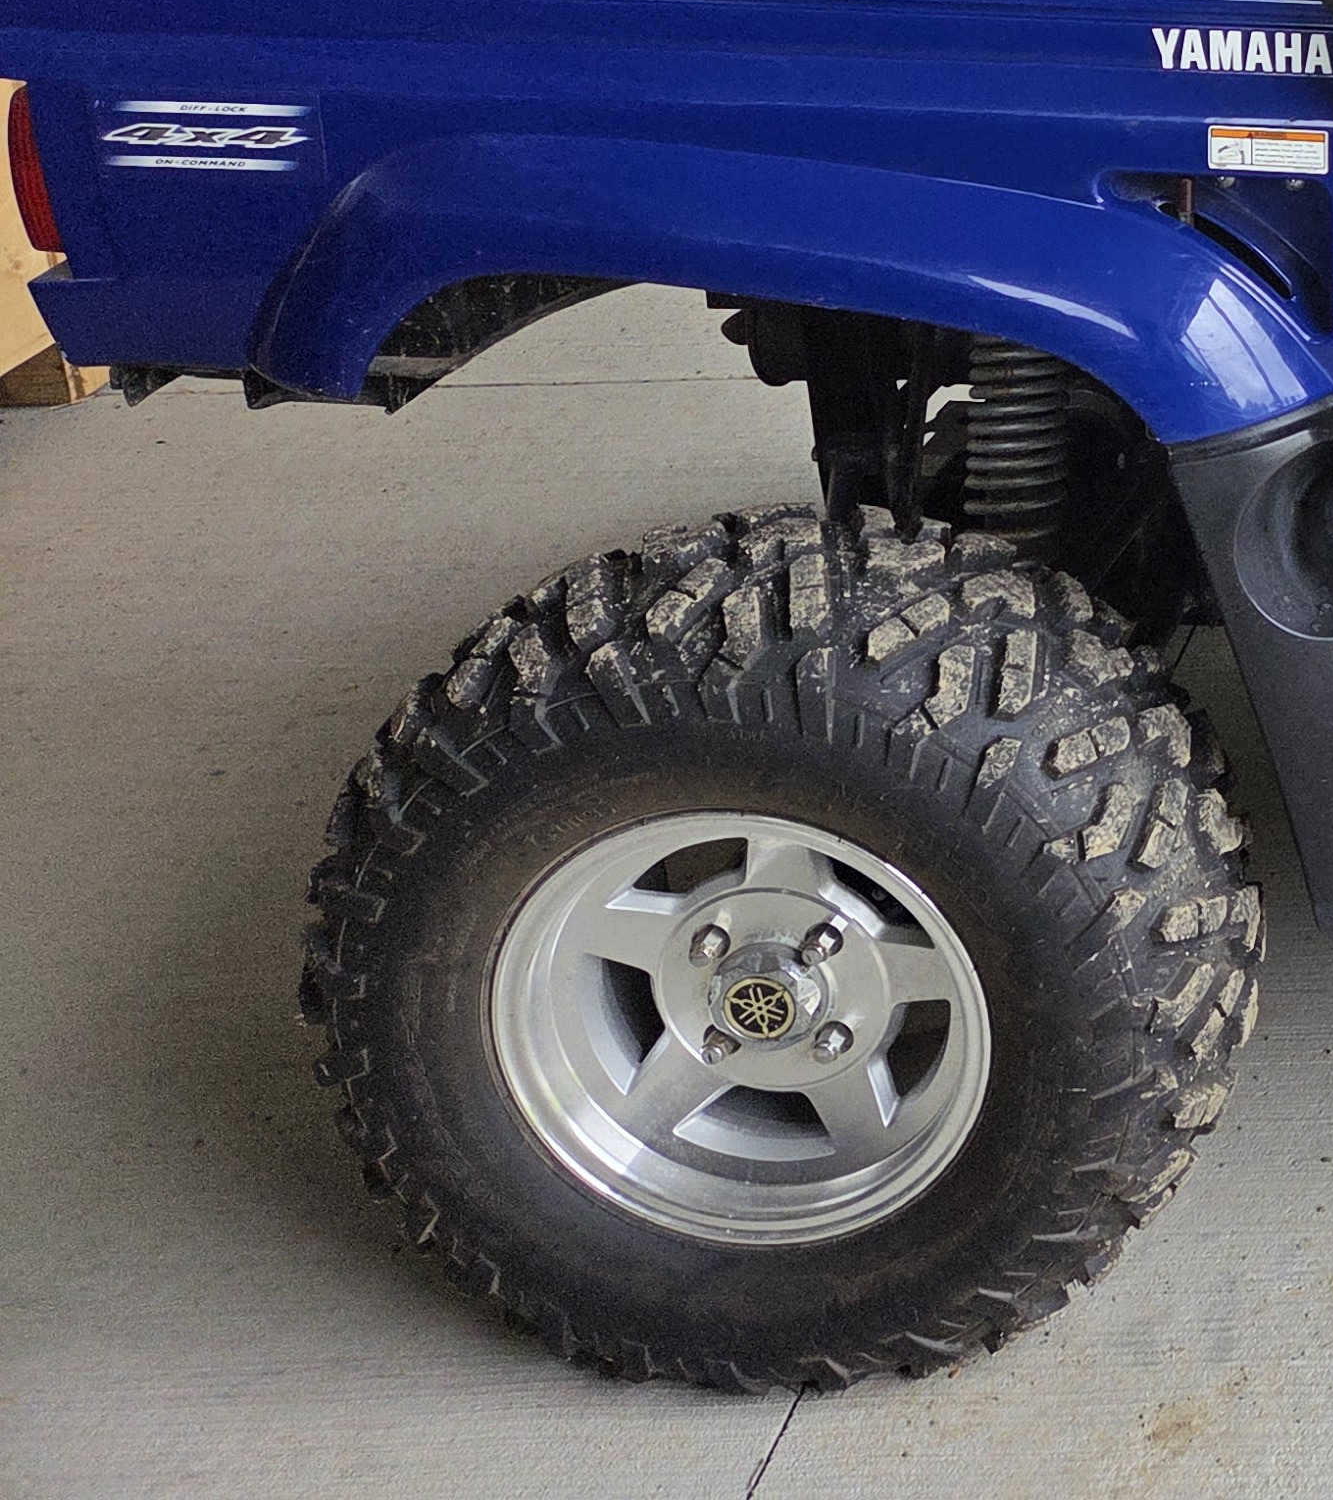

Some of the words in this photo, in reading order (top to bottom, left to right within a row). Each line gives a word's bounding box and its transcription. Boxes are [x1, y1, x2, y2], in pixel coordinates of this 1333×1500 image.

[1152, 28, 1333, 74] YAMAHA
[179, 104, 248, 114] DIFF-LOCK
[103, 123, 305, 148] 4x4
[154, 158, 247, 168] ON-COMMAND
